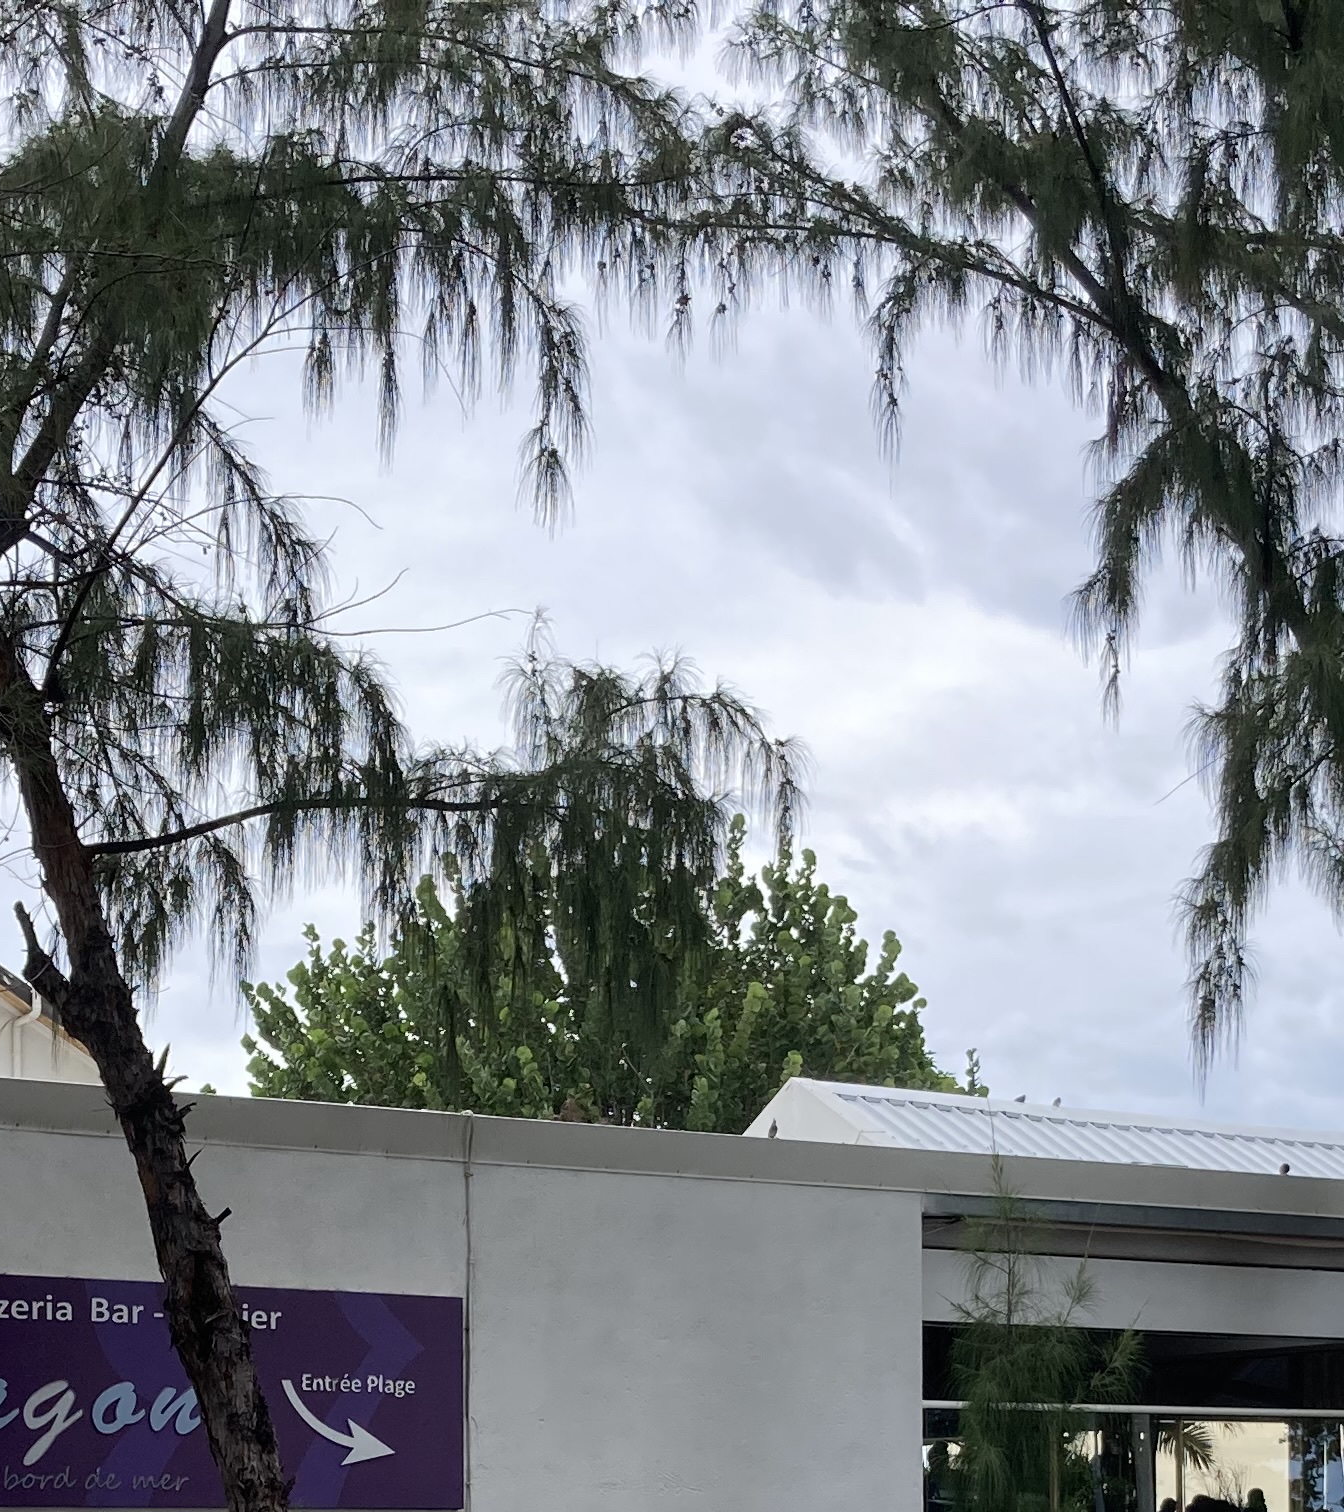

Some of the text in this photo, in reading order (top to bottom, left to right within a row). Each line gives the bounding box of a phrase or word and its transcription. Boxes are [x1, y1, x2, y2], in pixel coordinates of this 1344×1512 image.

[90, 1297, 145, 1325] Bar
[301, 1373, 416, 1398] Entrée Plage
[3, 1465, 77, 1491] bord
[84, 1467, 122, 1491] de
[132, 1471, 190, 1492] mer
